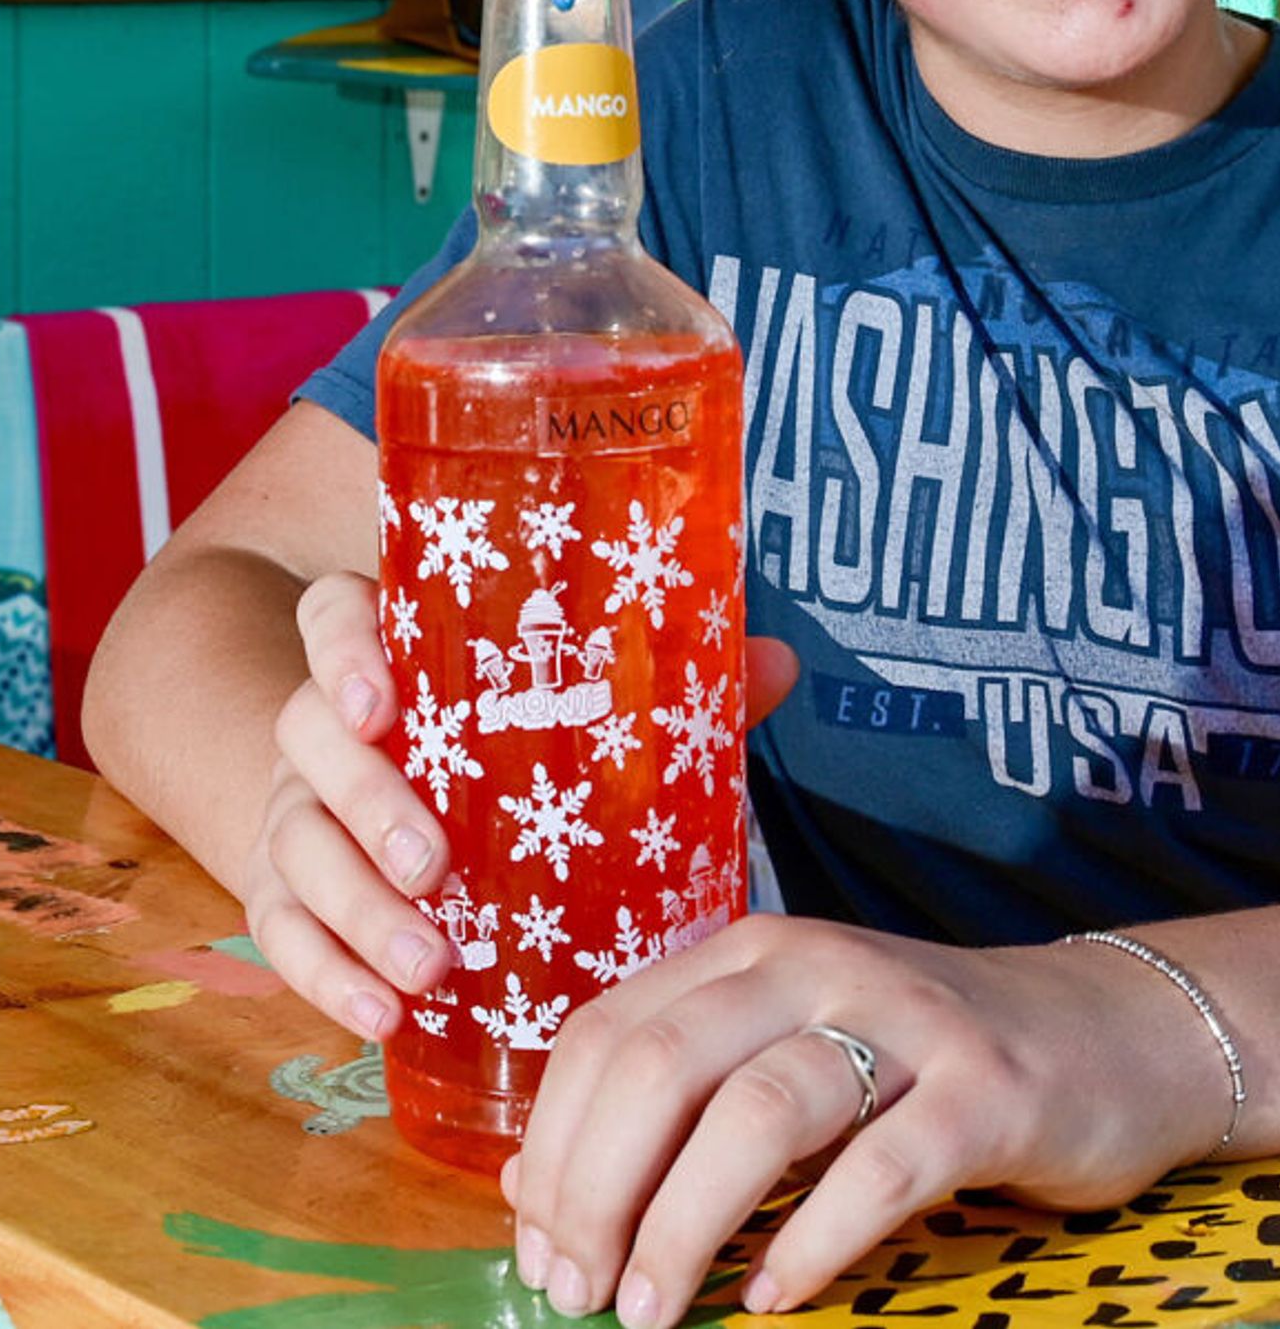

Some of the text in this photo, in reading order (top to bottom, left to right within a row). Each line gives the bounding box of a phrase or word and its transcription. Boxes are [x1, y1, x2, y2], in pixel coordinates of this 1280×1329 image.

[530, 93, 628, 119] MANGO
[547, 400, 692, 444] MANGO
[476, 680, 612, 734] SNOWIE
[835, 684, 943, 734] EST.
[984, 676, 1203, 812] USA
